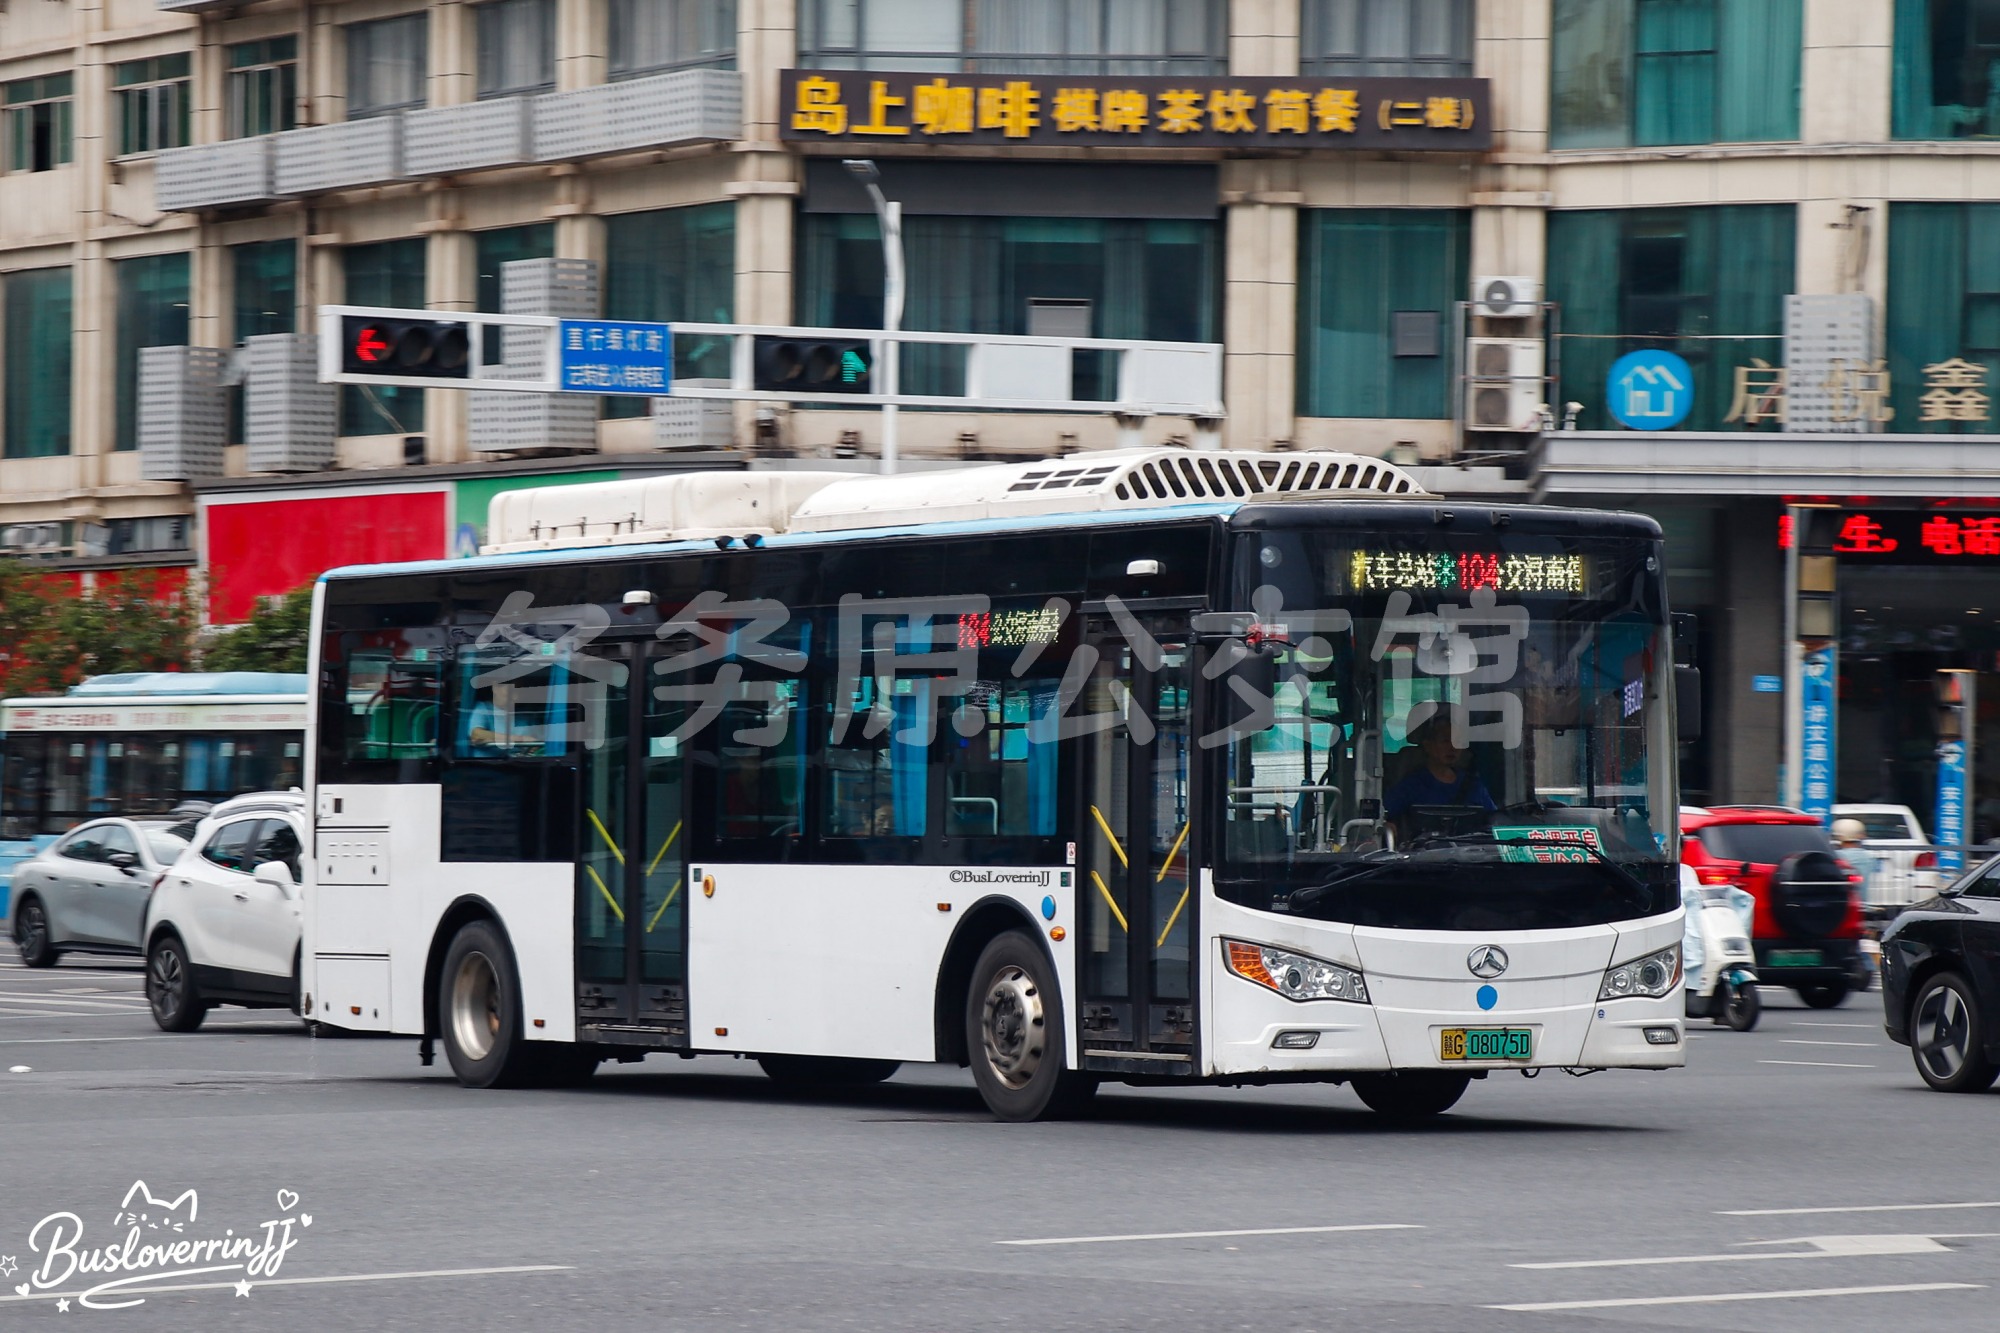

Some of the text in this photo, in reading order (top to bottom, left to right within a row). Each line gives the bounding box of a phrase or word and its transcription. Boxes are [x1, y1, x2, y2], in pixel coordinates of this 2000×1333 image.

[796, 76, 1041, 138] 岛上咖啡
[1458, 552, 1498, 591] 104
